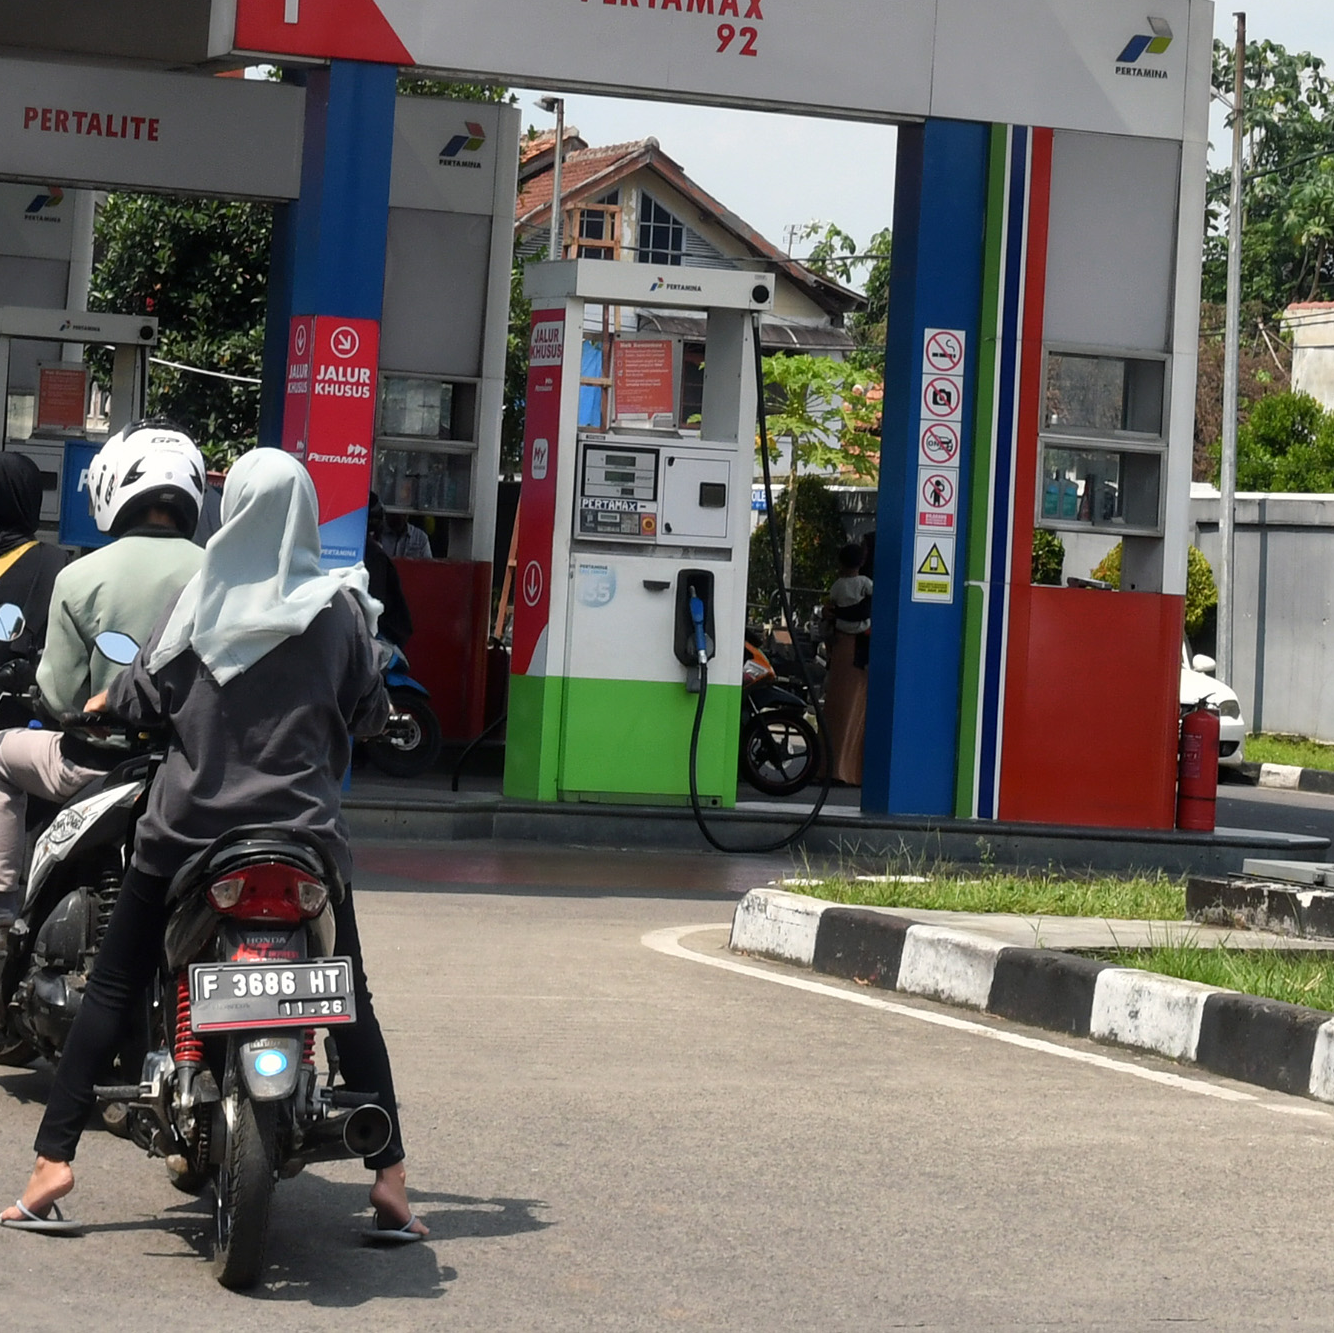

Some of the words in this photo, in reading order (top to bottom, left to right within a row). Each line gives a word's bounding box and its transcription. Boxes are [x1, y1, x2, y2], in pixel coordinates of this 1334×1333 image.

[717, 24, 758, 56] 92
[1115, 67, 1168, 79] PERTAMINA
[24, 106, 160, 141] PERTALITE
[439, 159, 481, 169] PERTAMINA
[666, 284, 702, 292] PERTAMINA
[534, 328, 559, 342] JALUR
[530, 344, 563, 359] KHUSUS
[288, 364, 309, 379] JALUR
[316, 364, 371, 383] JALUR
[287, 381, 308, 394] KHUSUS
[314, 382, 371, 398] KHUSUS
[308, 452, 367, 465] PERTAMAX
[582, 499, 637, 511] PERTAMAX
[246, 936, 287, 944] HONDA
[203, 975, 218, 999] F
[232, 971, 296, 997] 3686
[310, 969, 340, 994] HT
